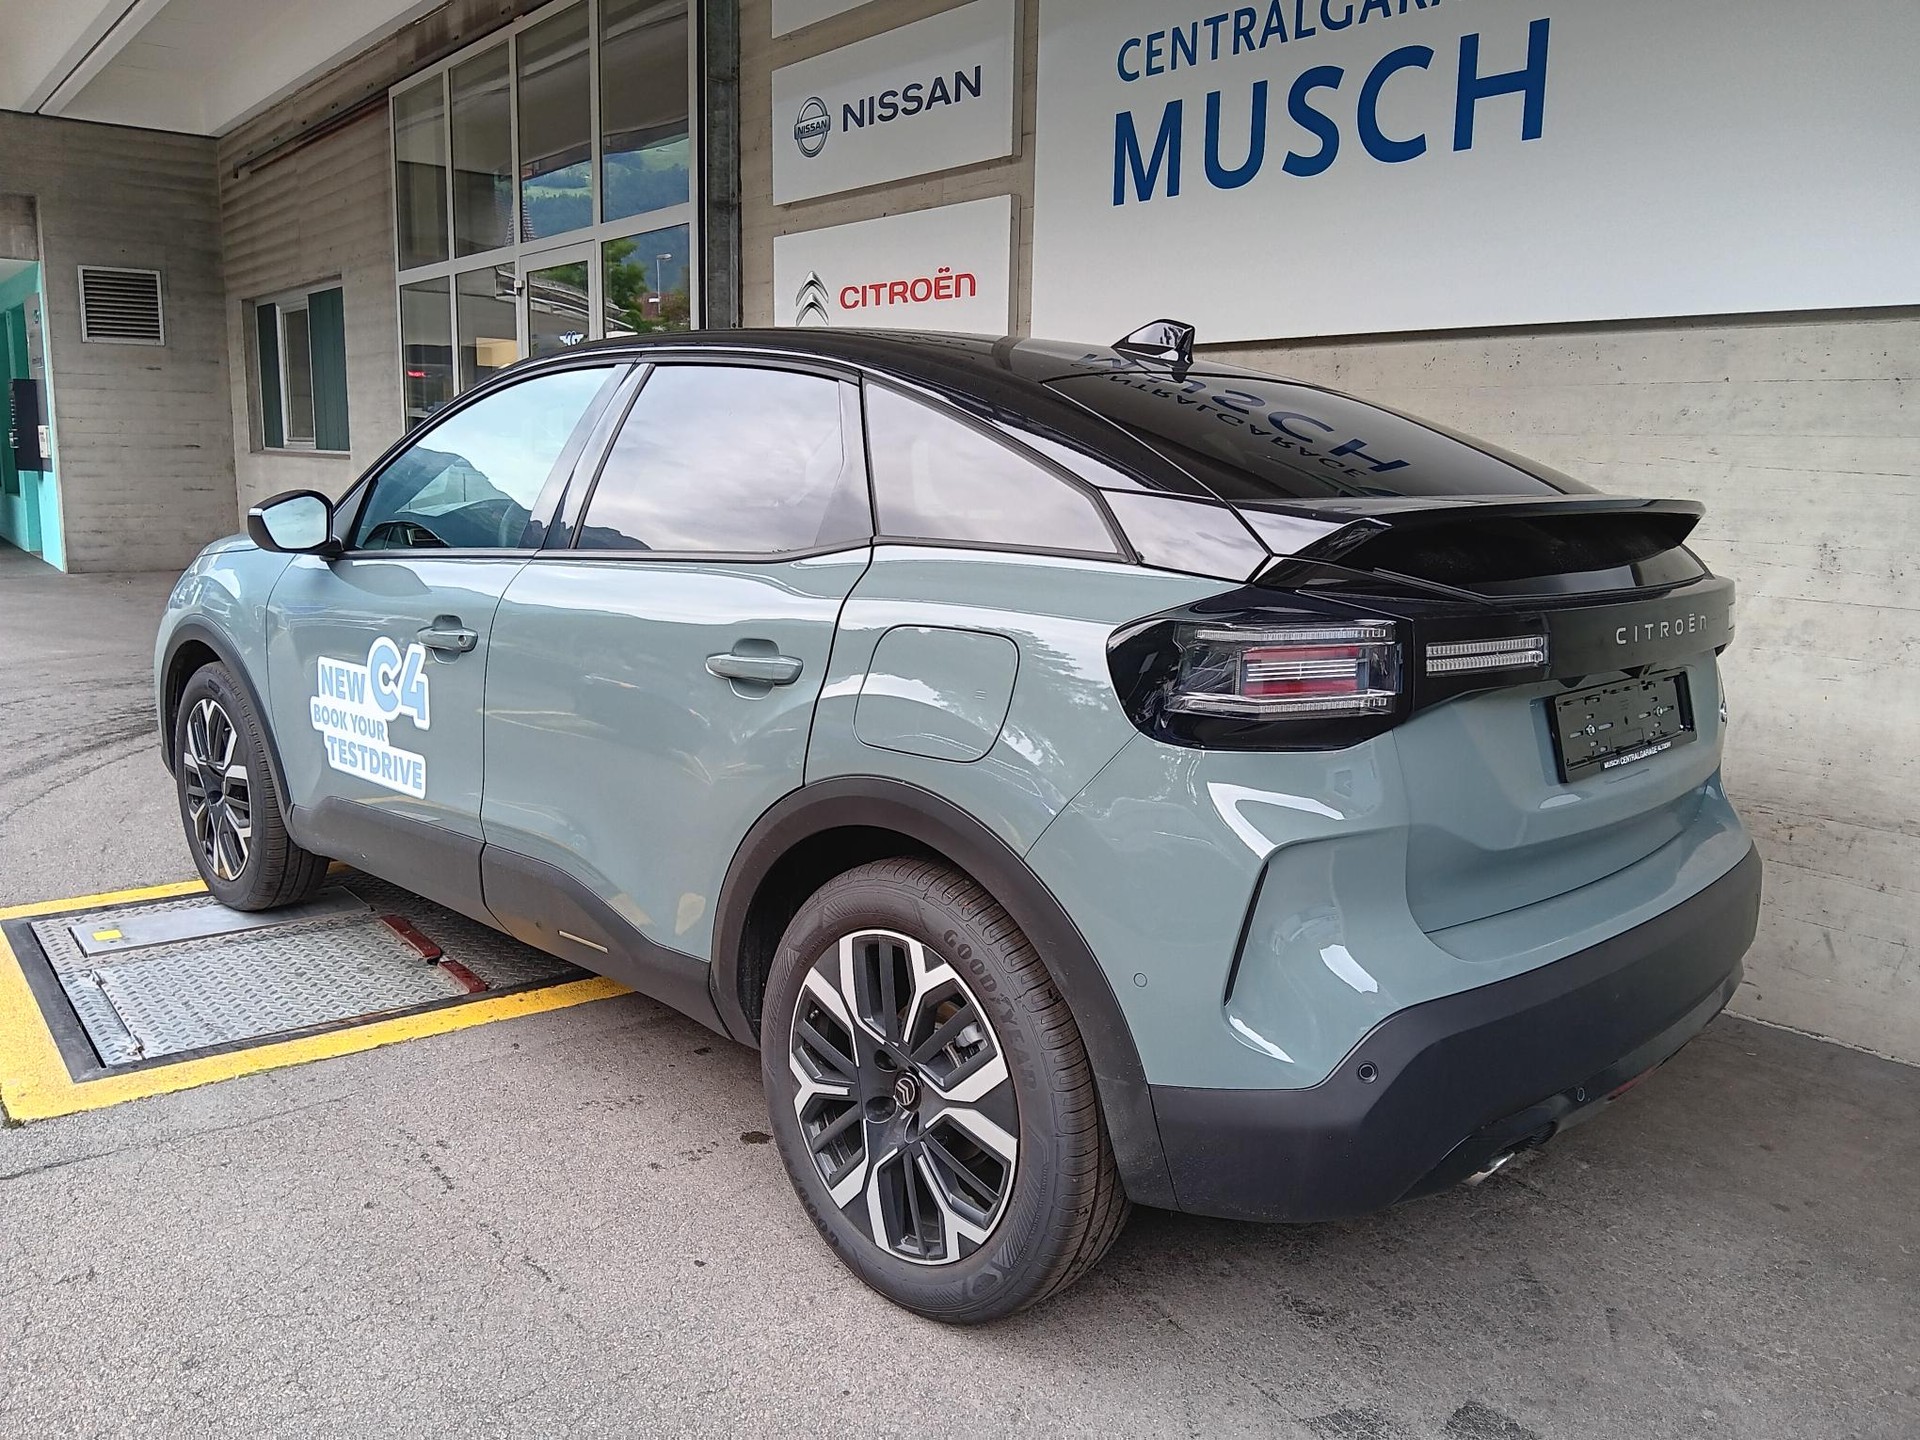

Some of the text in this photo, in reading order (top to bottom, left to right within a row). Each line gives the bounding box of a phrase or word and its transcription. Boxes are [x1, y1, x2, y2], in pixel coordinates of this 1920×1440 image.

[1117, 0, 1441, 82] CENTRALG
[797, 119, 828, 136] NISSAN
[842, 65, 981, 132] NISSAN
[1113, 17, 1551, 206] MUSCH
[321, 644, 426, 721] NEW C4
[313, 703, 385, 742] BOOK YOUR
[327, 735, 423, 790] TESTDRIVE
